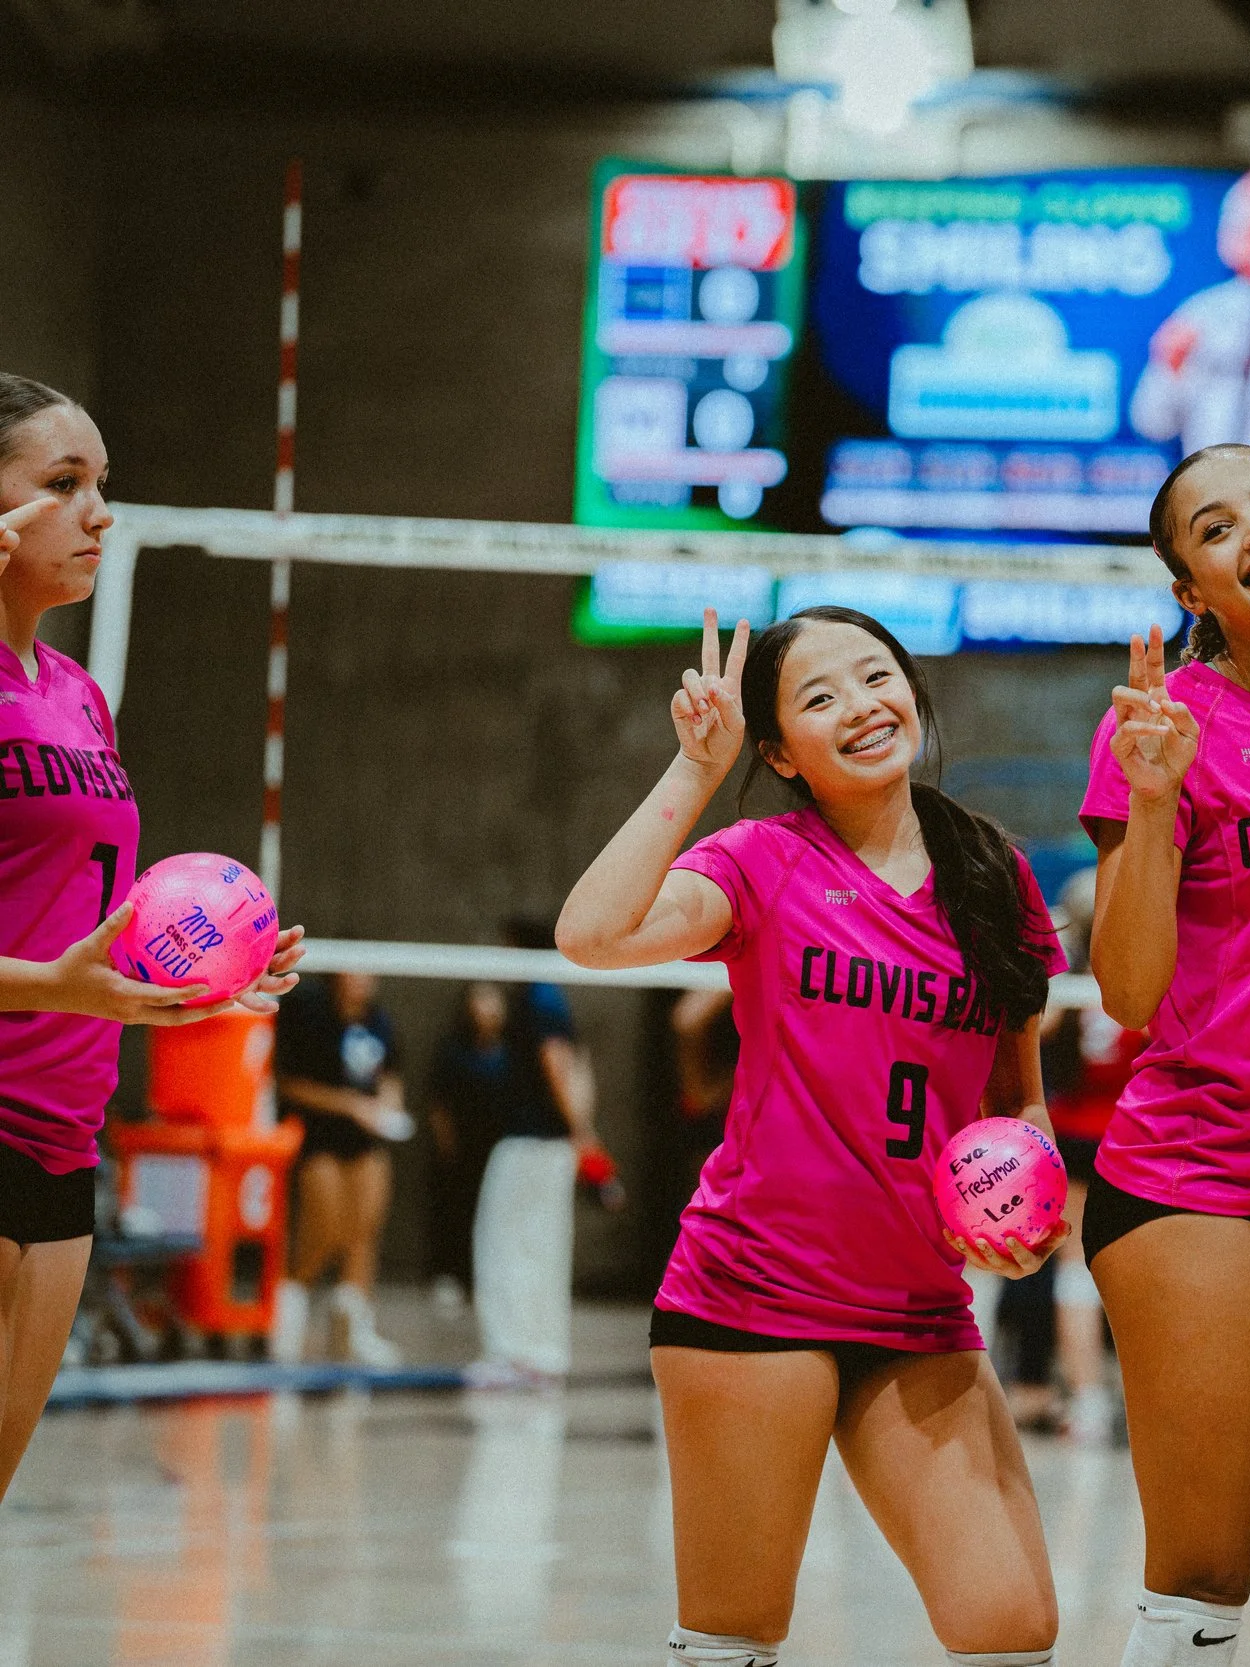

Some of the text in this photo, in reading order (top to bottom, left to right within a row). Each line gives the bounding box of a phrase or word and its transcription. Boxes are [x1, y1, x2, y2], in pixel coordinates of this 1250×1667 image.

[825, 889, 849, 898] HIGH
[826, 896, 849, 905] FIVE
[800, 946, 937, 1023] CLOVIS
[885, 1061, 930, 1161] 9
[949, 1148, 988, 1176] Eva
[956, 1157, 1020, 1204] Freshman
[984, 1195, 1023, 1222] Lee
